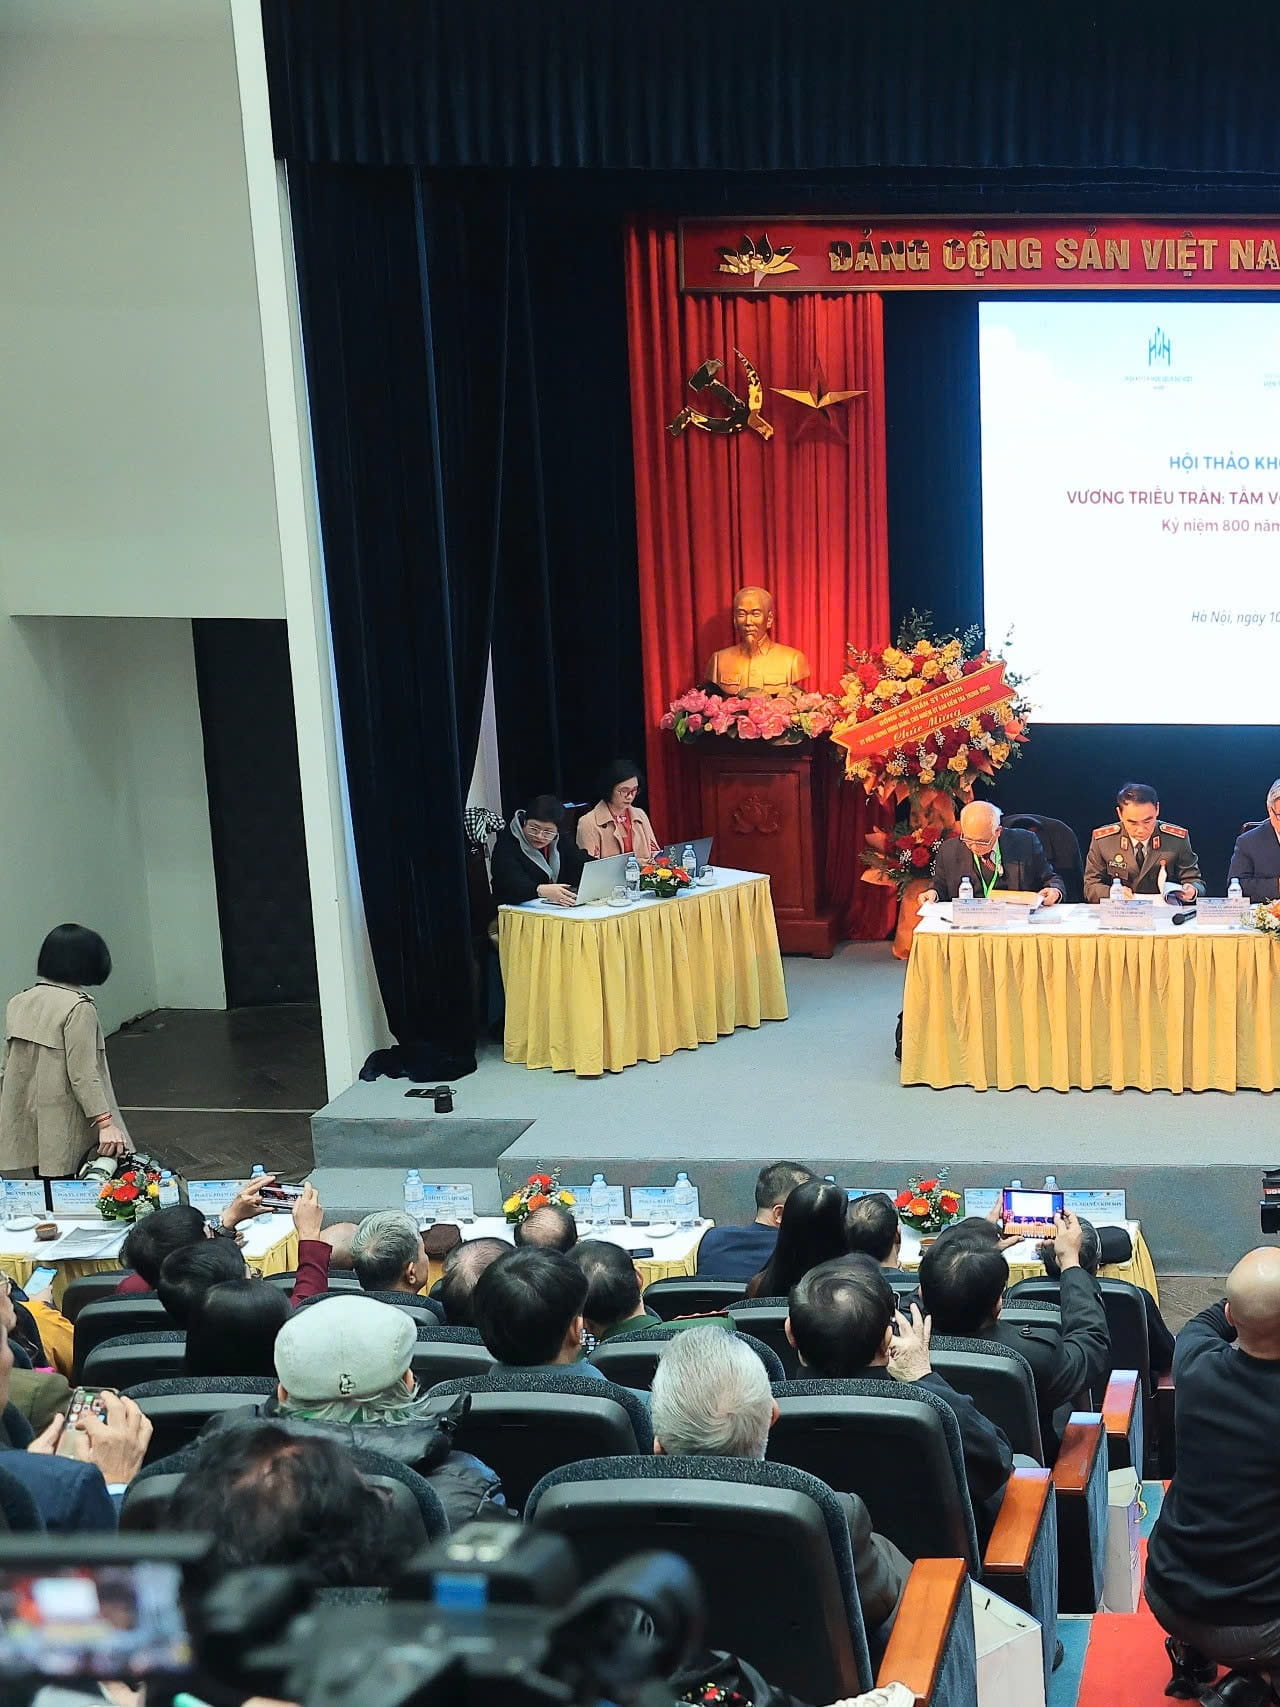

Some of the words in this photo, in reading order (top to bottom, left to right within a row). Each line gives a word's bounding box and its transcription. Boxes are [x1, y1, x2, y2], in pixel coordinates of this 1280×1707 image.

[829, 227, 930, 271] ĐẢNG
[943, 230, 1042, 277] CỘNG
[1055, 225, 1130, 270] SẢN
[1141, 230, 1218, 277] VIỆT
[1169, 451, 1199, 475] HỘI
[1203, 450, 1250, 471] THẢO
[1067, 488, 1125, 505] VƯƠNG
[1128, 485, 1174, 505] TRIỀU
[1183, 518, 1219, 536] niệm
[1222, 519, 1250, 532] 800
[1191, 609, 1208, 622] Hà
[1236, 610, 1267, 627] ngày
